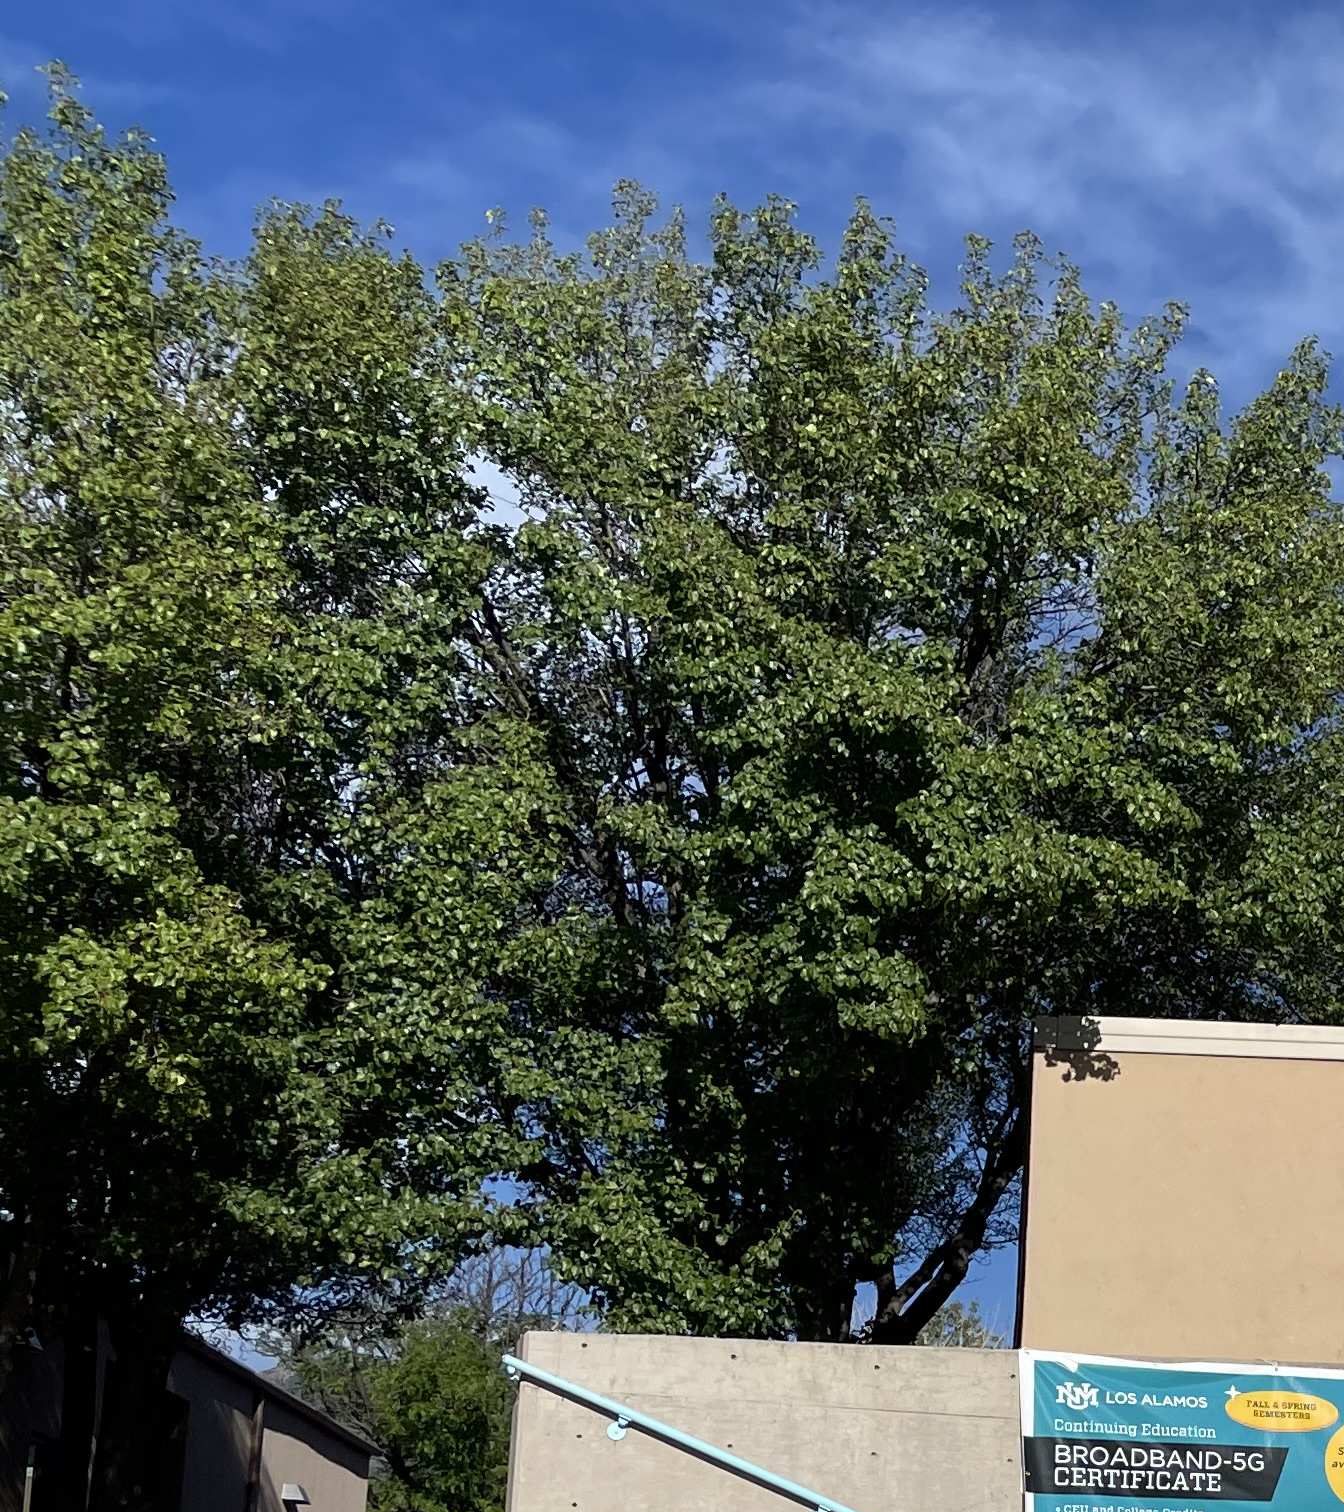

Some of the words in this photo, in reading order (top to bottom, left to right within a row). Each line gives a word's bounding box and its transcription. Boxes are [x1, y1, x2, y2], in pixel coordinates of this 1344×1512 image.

[1106, 1391, 1137, 1405] LOS
[1141, 1393, 1208, 1409] ALAMOS
[1246, 1400, 1270, 1409] FALL
[1272, 1401, 1279, 1409] &
[1281, 1402, 1317, 1411] SPRING
[1253, 1410, 1311, 1420] SEMESTERS
[1054, 1418, 1138, 1437] Continuing
[1142, 1423, 1217, 1439] Education
[1054, 1444, 1265, 1472] BROADBAND-5G
[1054, 1466, 1222, 1492] CERTIFICATE
